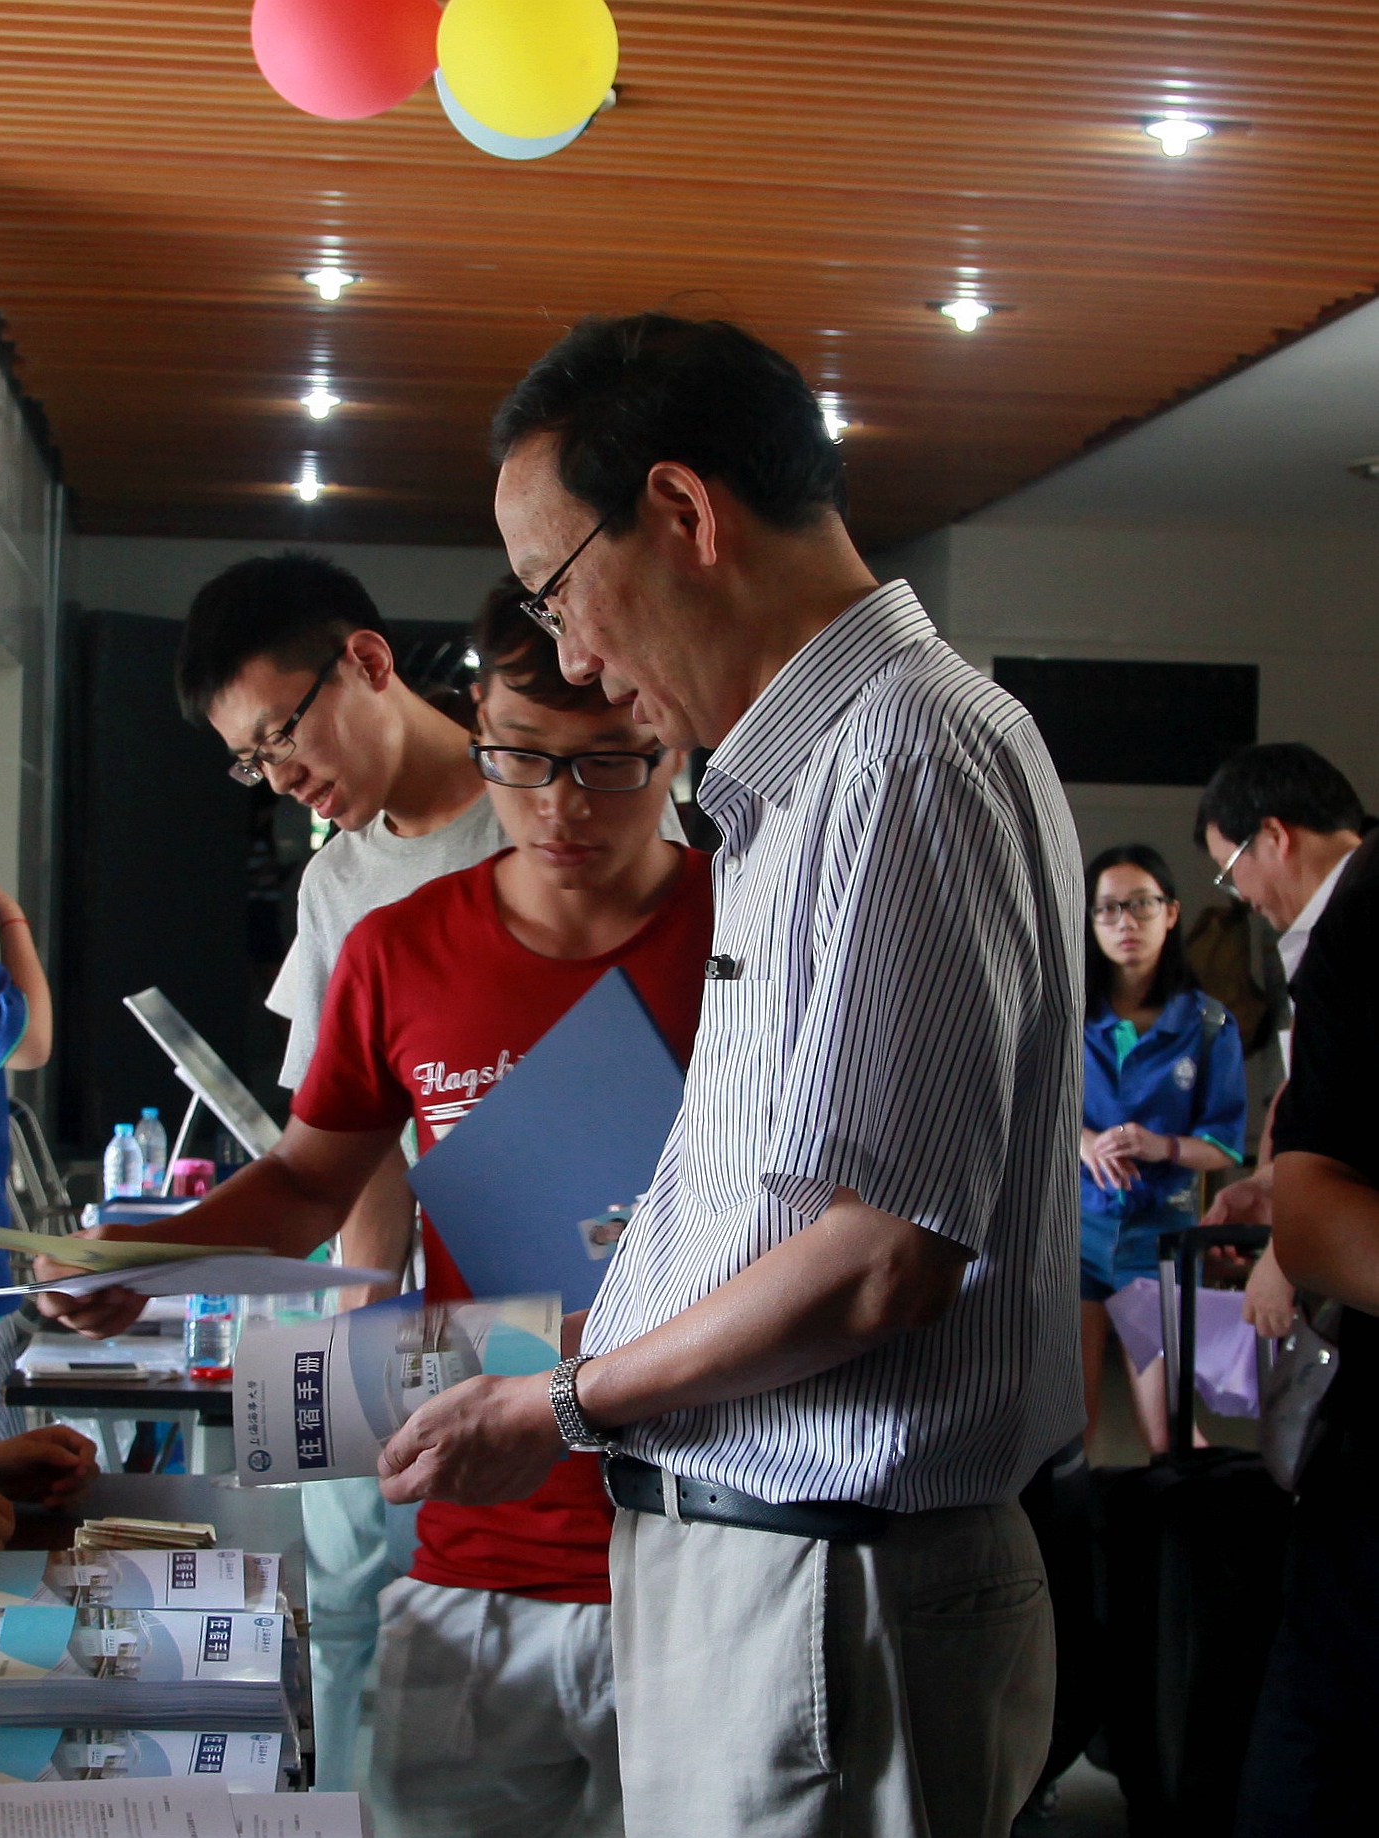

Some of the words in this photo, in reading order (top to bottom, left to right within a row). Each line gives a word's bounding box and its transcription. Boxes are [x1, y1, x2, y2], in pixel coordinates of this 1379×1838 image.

[413, 1050, 525, 1097] Flagsh
[297, 1356, 323, 1460] 住宿手册
